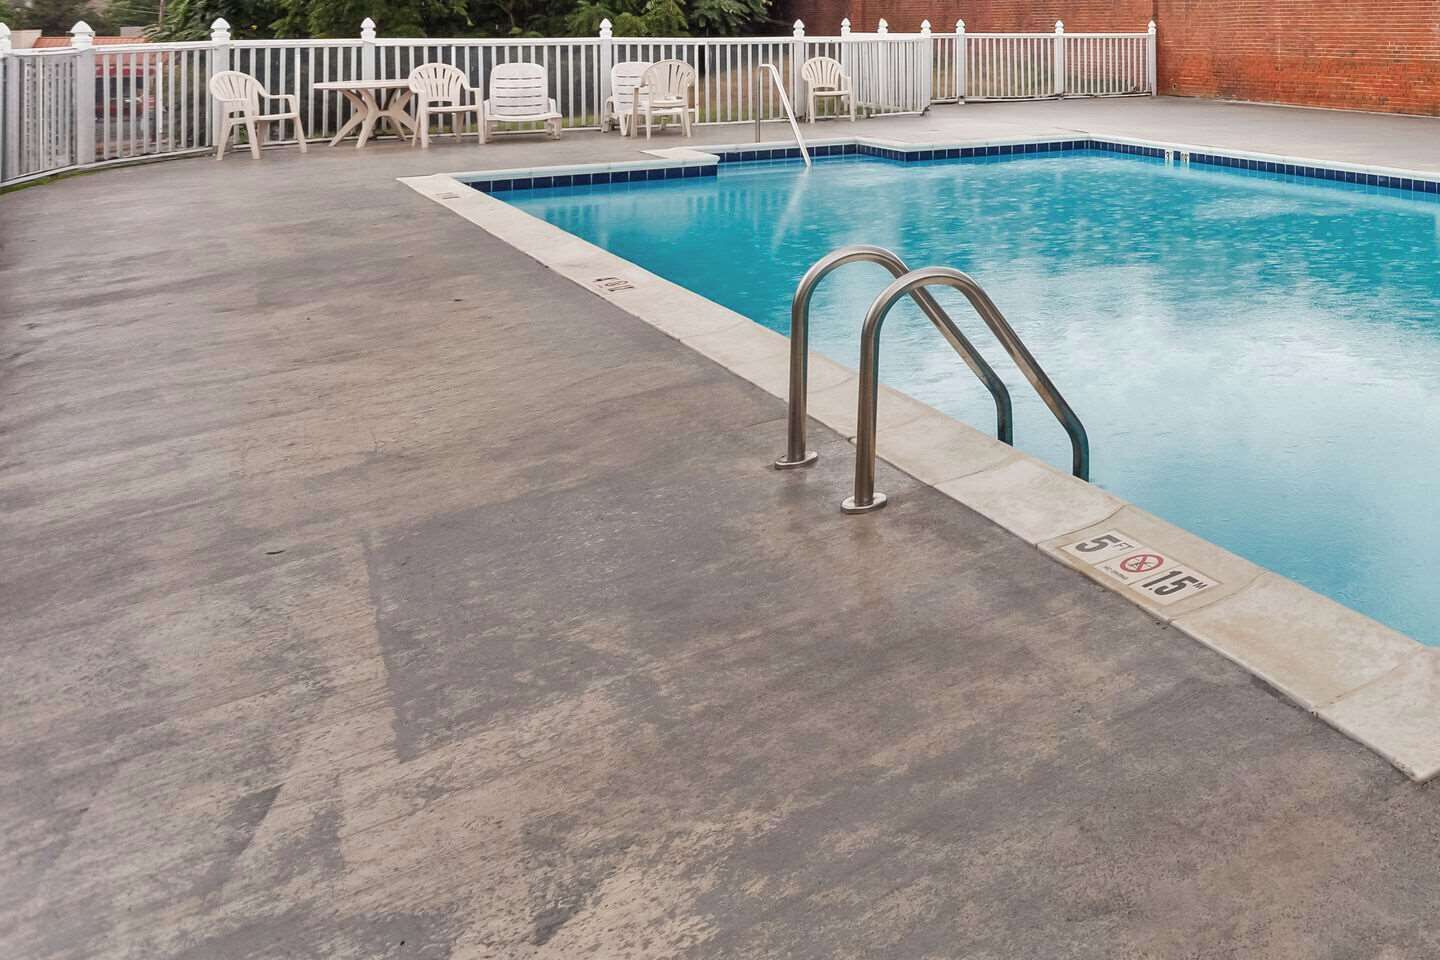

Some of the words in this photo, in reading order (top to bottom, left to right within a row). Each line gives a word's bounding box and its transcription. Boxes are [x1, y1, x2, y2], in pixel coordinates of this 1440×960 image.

[1075, 534, 1120, 553] 5
[1117, 541, 1135, 551] FT
[1195, 581, 1208, 590] M
